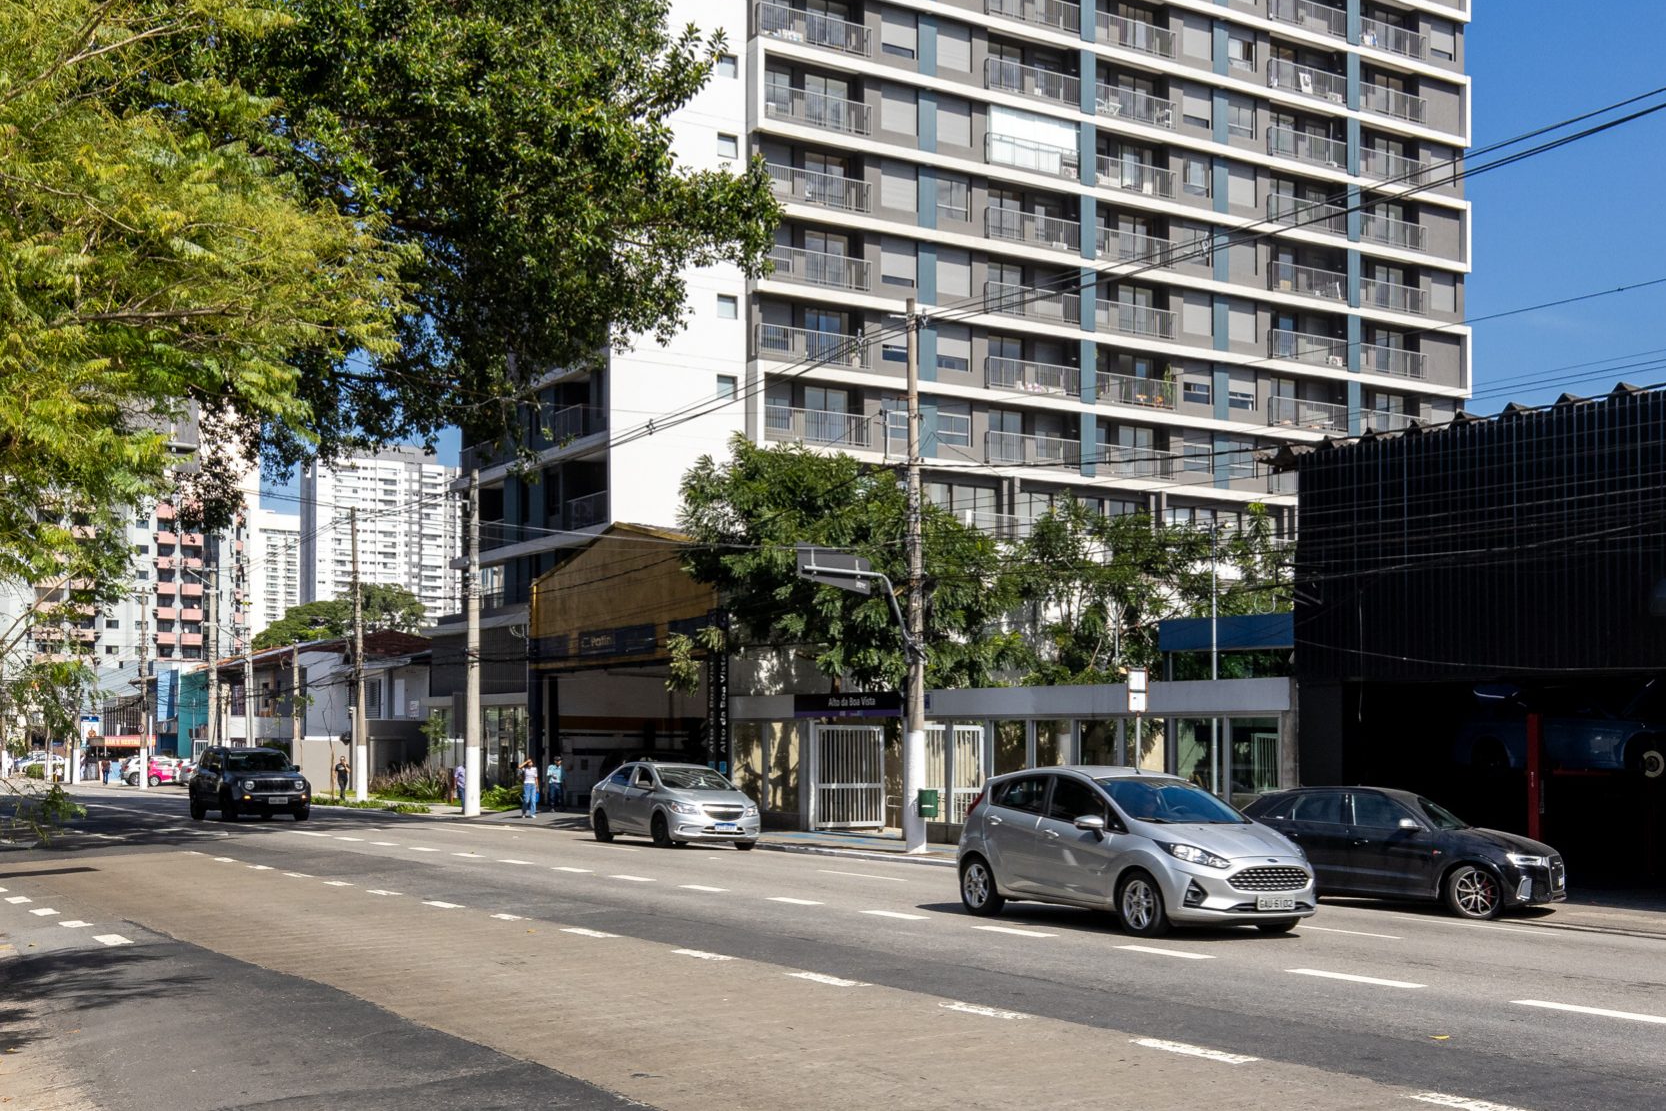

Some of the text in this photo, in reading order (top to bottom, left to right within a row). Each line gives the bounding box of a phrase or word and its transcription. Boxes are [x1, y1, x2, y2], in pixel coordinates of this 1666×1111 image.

[828, 696, 876, 707] Alto da Boa Vista
[720, 711, 726, 726] da
